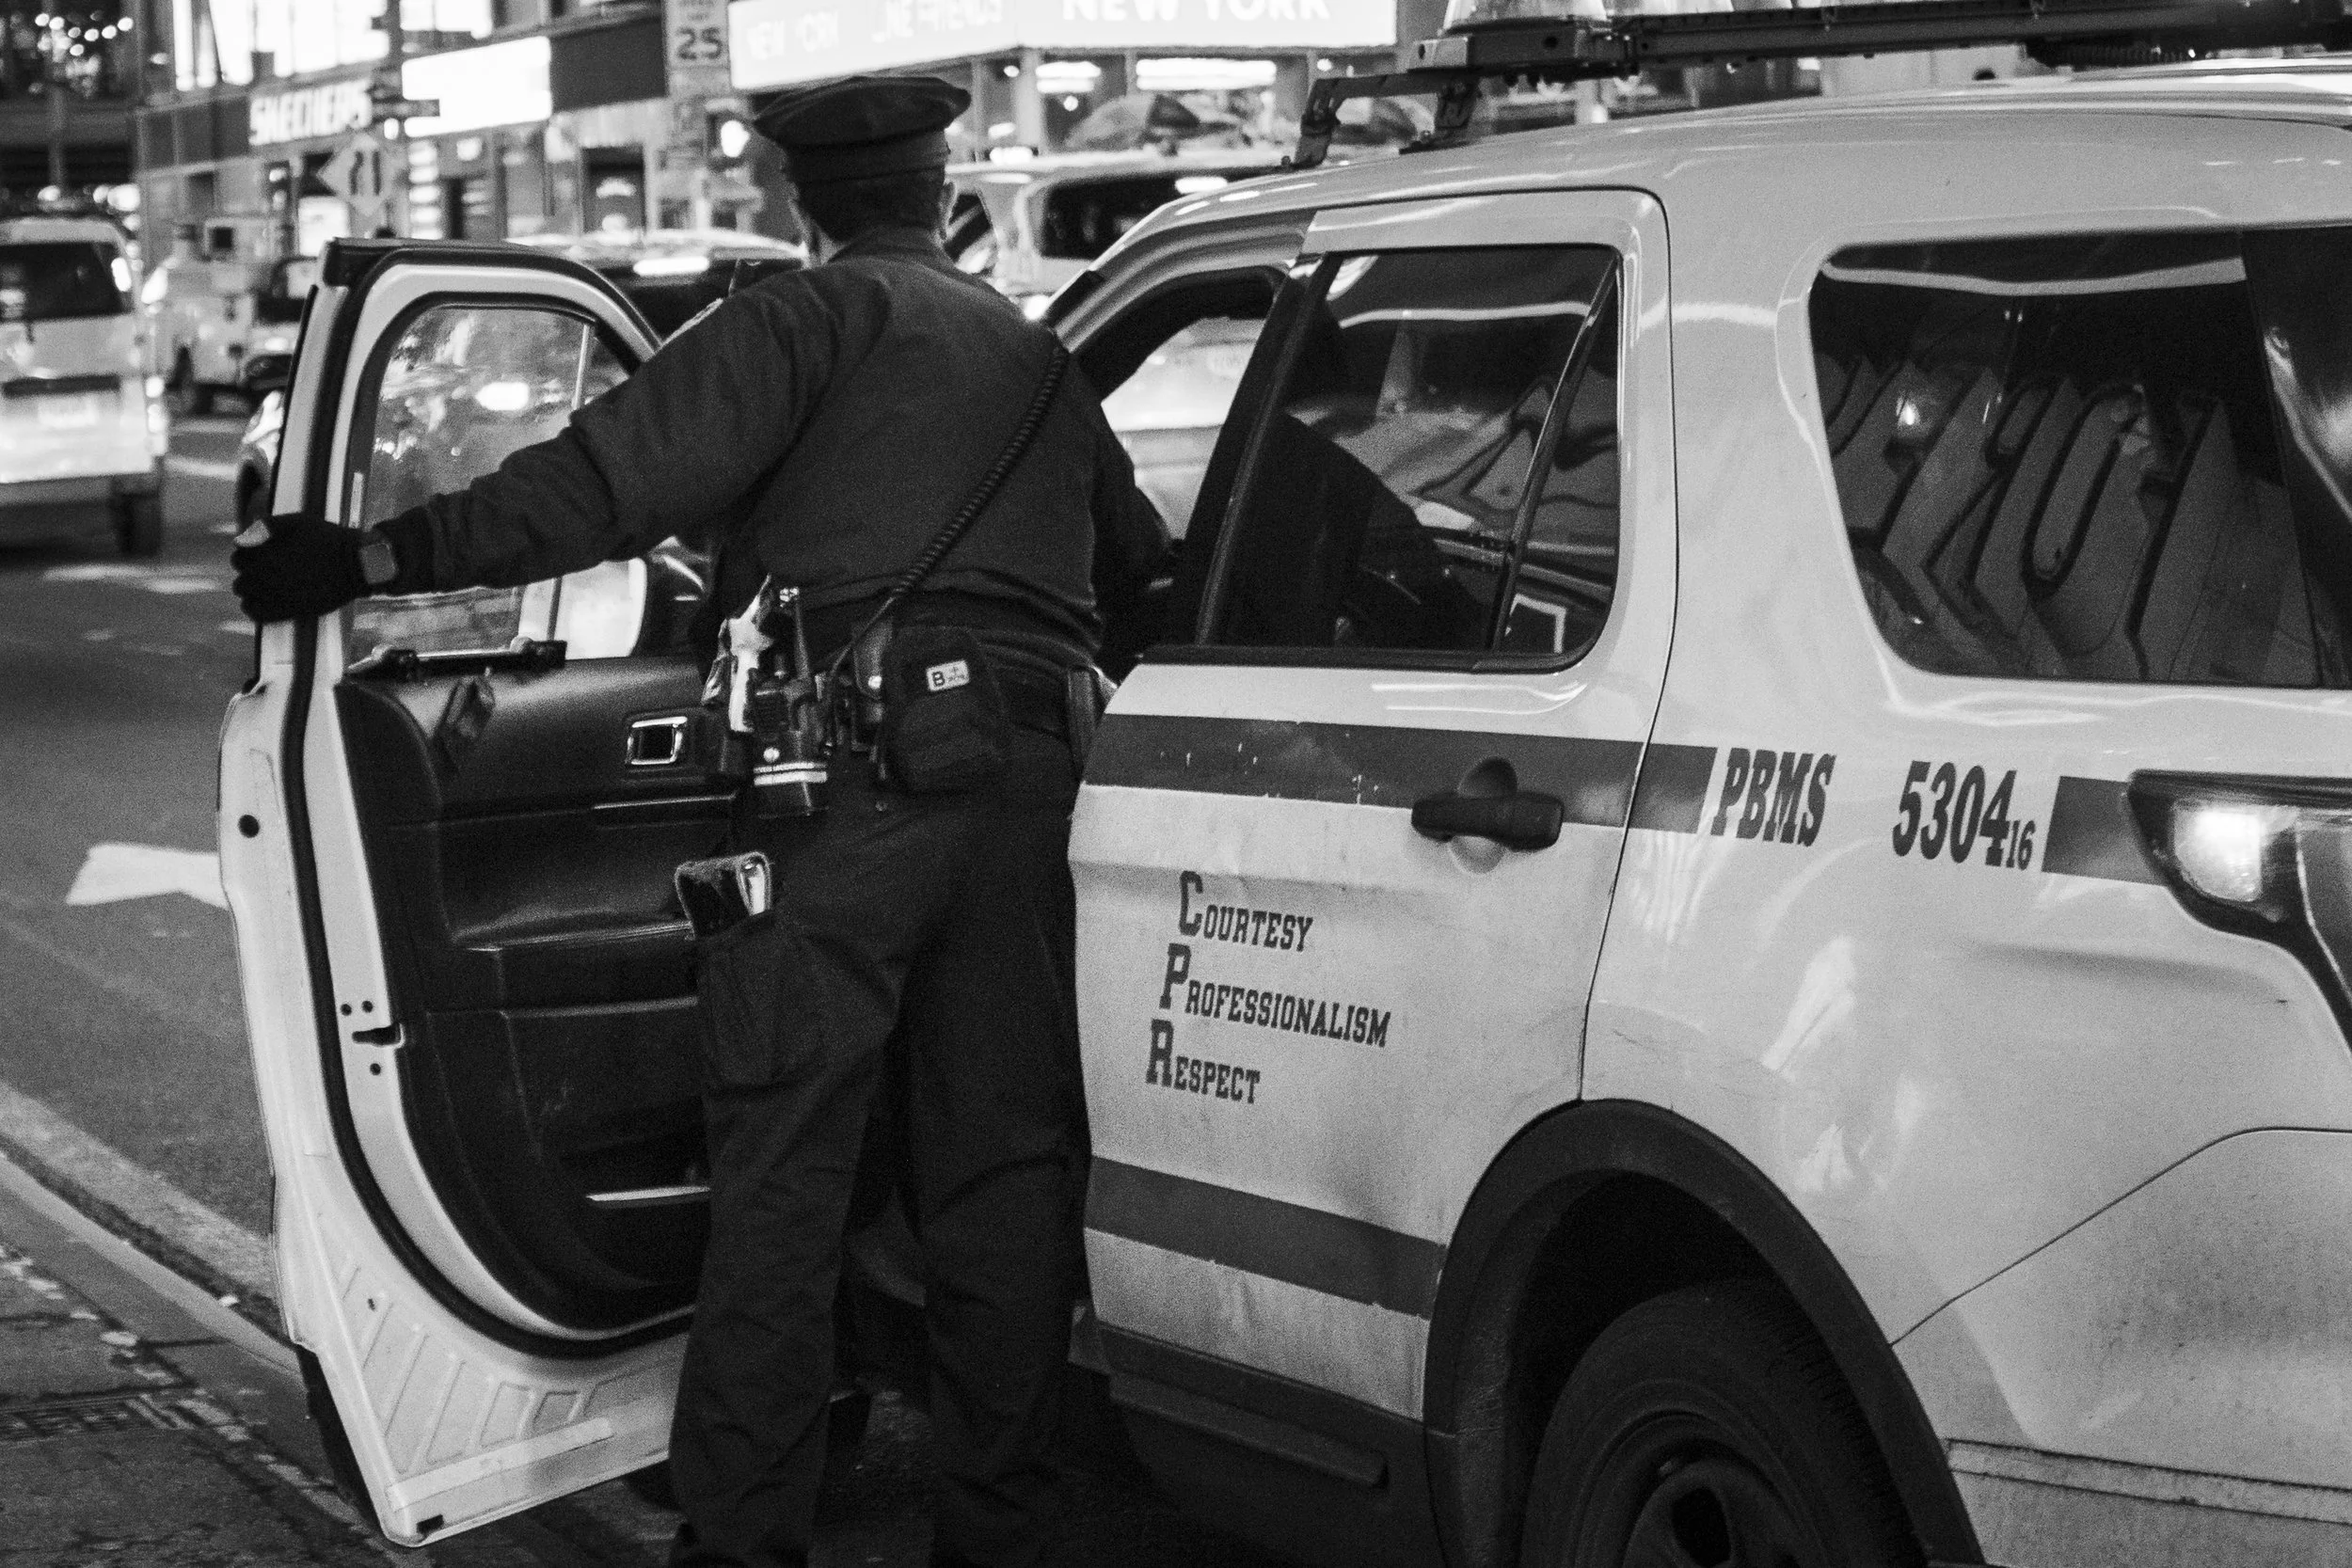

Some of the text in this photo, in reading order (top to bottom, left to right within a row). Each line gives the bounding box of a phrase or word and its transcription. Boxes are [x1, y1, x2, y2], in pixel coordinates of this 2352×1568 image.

[676, 26, 723, 61] 25
[1710, 747, 1837, 847] PBMS
[1177, 870, 1314, 952] COURTESY
[1158, 942, 1391, 1048] PROFESSIONALISM
[1145, 1018, 1261, 1104] RESPECT
